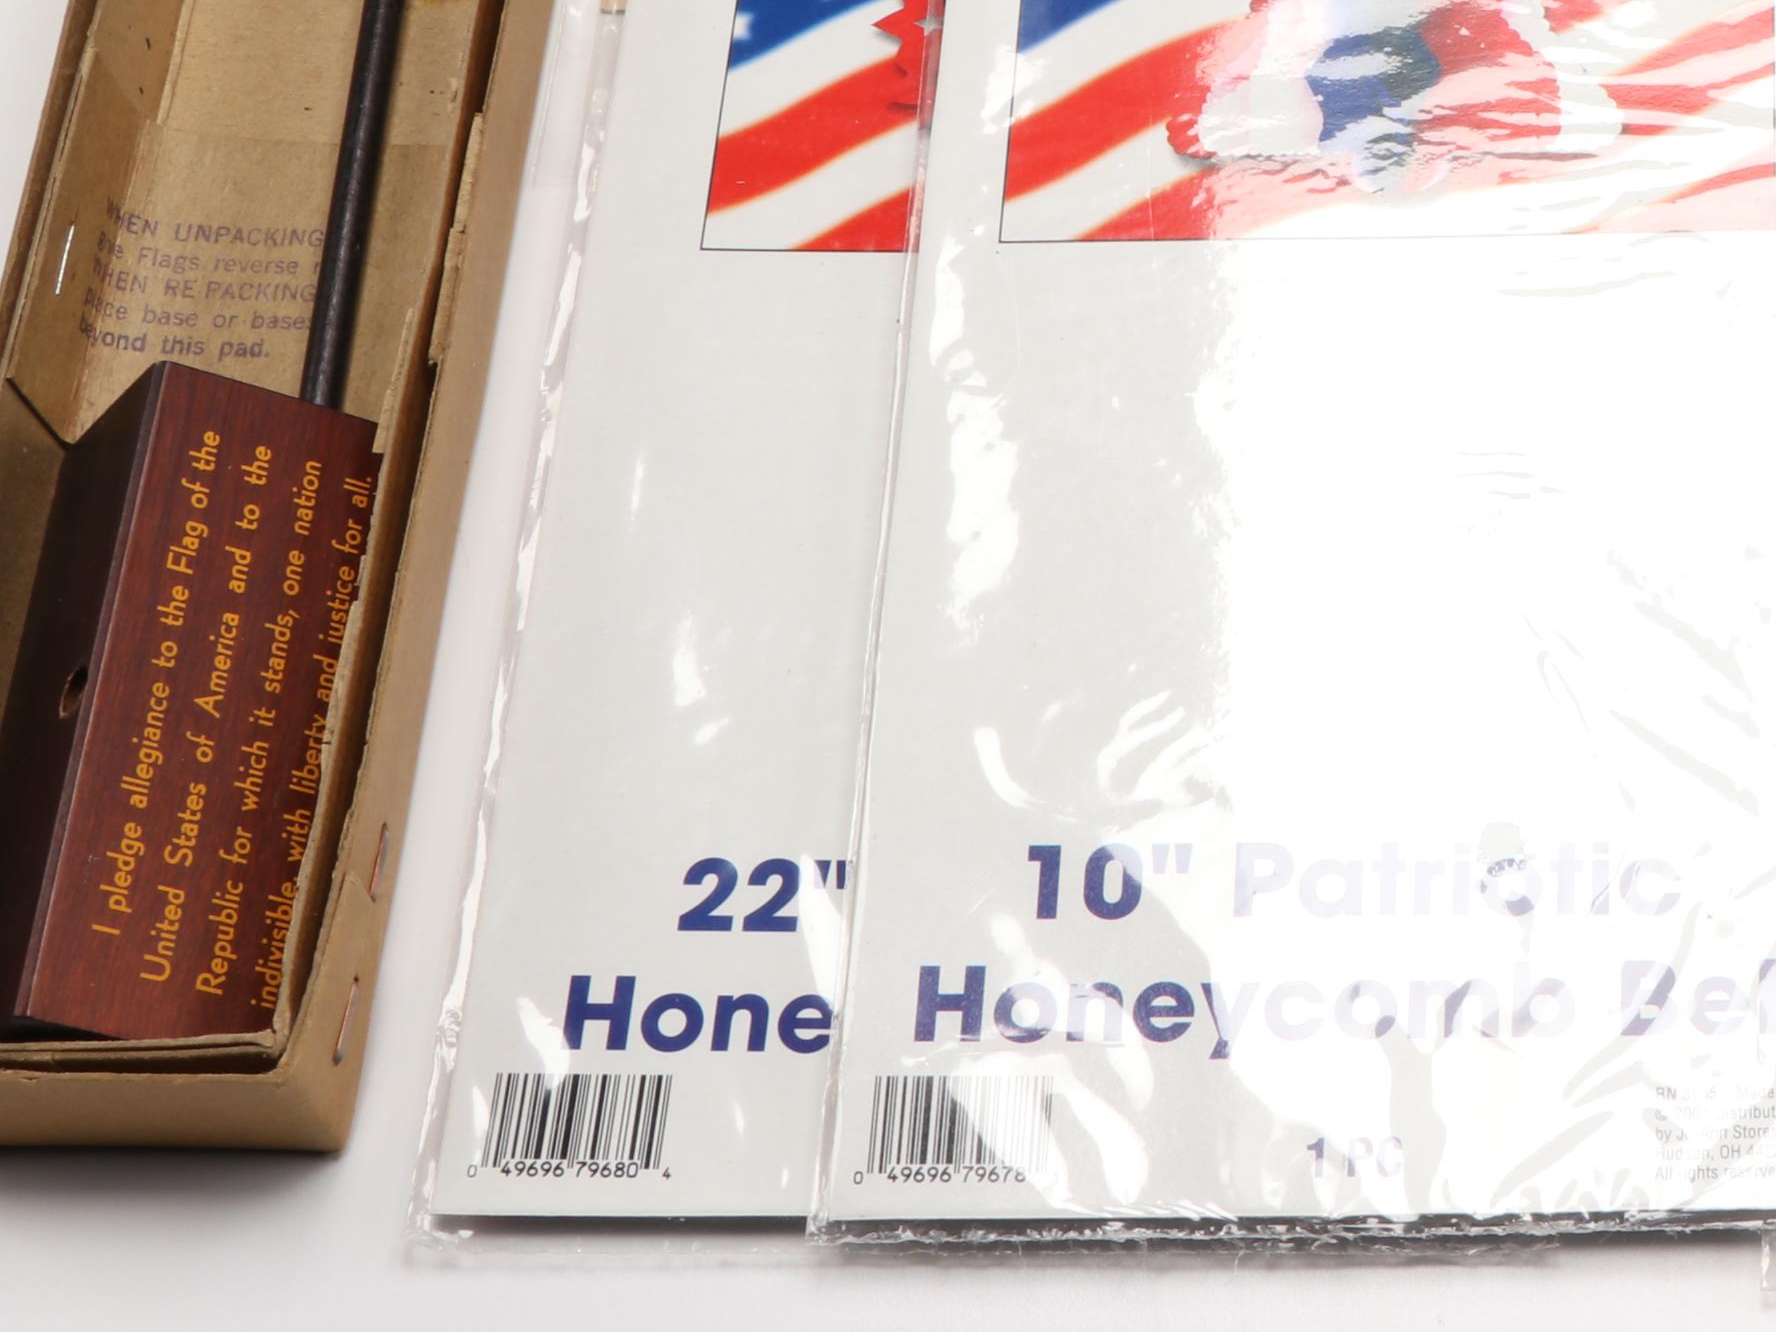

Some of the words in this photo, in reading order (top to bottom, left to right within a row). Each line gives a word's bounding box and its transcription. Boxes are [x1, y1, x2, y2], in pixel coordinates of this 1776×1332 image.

[174, 222, 325, 249] UNPACKING
[213, 256, 299, 276] reverse
[78, 312, 147, 354] beyond
[161, 336, 206, 358] this
[218, 337, 270, 363] pad.
[142, 302, 200, 329] base
[212, 311, 239, 330] or
[188, 430, 222, 472] the
[240, 445, 273, 486] the
[180, 477, 210, 509] of
[292, 459, 323, 536] nation
[343, 475, 373, 509] all.
[234, 503, 261, 530] to
[331, 519, 363, 555] for
[165, 520, 209, 575] Flag
[224, 545, 252, 594] and
[282, 549, 306, 596] one
[157, 584, 190, 627] the
[151, 640, 178, 669] to
[193, 611, 240, 719] America
[260, 609, 302, 695] stands,
[312, 653, 341, 702] and
[249, 706, 276, 727] it
[120, 681, 170, 810] allegiance
[186, 730, 215, 763] of
[233, 740, 270, 812] which
[163, 781, 208, 868] States
[217, 826, 253, 864] for
[280, 807, 312, 862] with
[99, 821, 146, 913] pledge
[1027, 842, 1194, 922] 10"
[1232, 840, 1683, 919] Patriotic
[676, 856, 850, 933] 22"
[91, 923, 122, 936] I
[139, 884, 186, 983] United
[194, 879, 244, 996] Republic
[914, 960, 1577, 1060] Honeycomb
[501, 1161, 564, 1178] 49696
[575, 1161, 639, 1179] 79680
[661, 1169, 672, 1180] 4
[1305, 1136, 1326, 1178] 1
[1719, 1143, 1741, 1160] OH
[853, 1171, 864, 1185] 0
[886, 1166, 952, 1183] 49696
